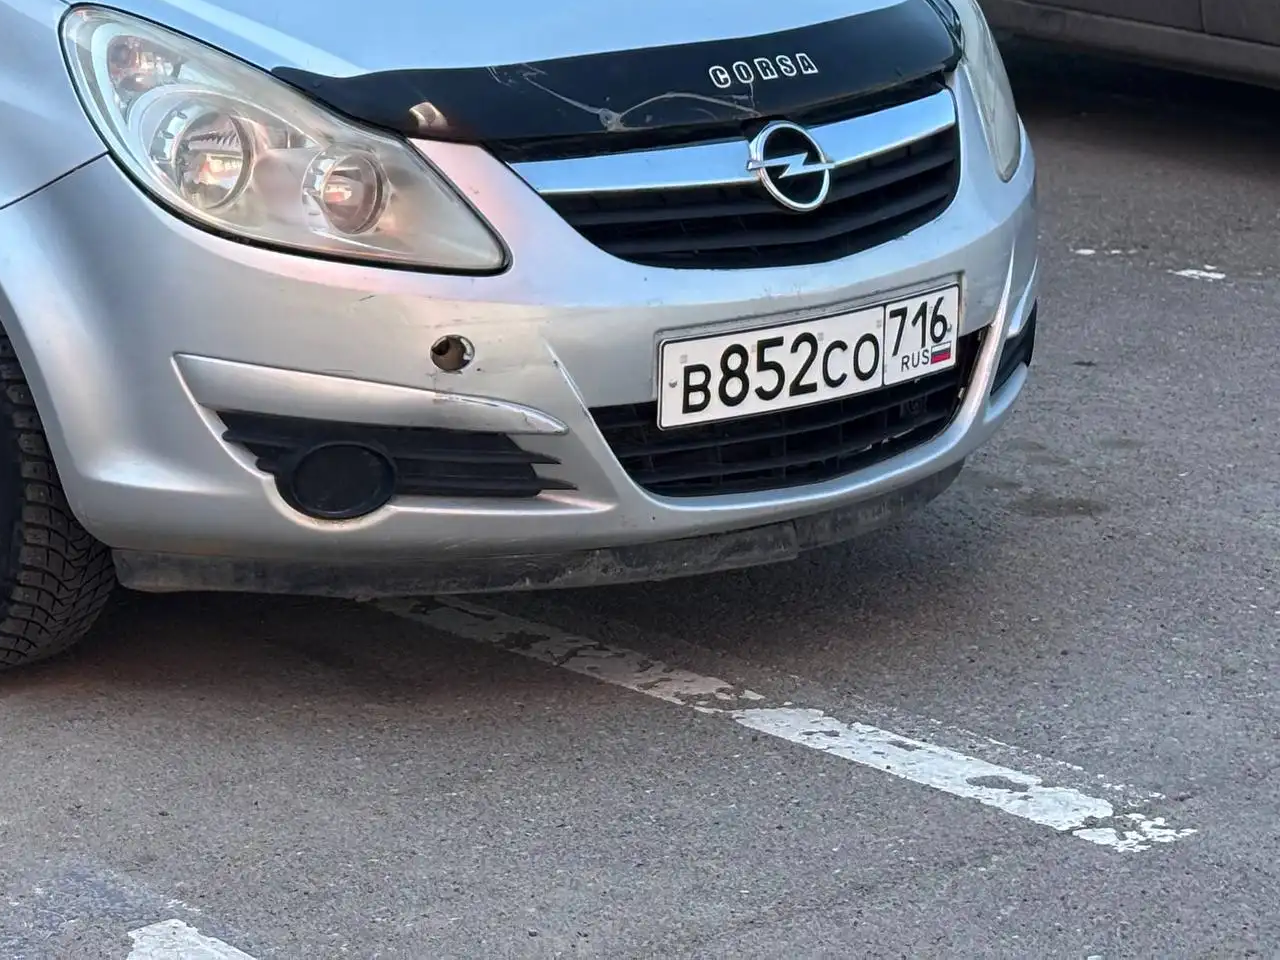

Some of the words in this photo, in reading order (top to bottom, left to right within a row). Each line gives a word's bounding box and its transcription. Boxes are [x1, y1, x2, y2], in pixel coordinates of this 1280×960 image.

[709, 53, 819, 88] CORSA
[889, 296, 948, 358] 716
[901, 349, 930, 373] RUS
